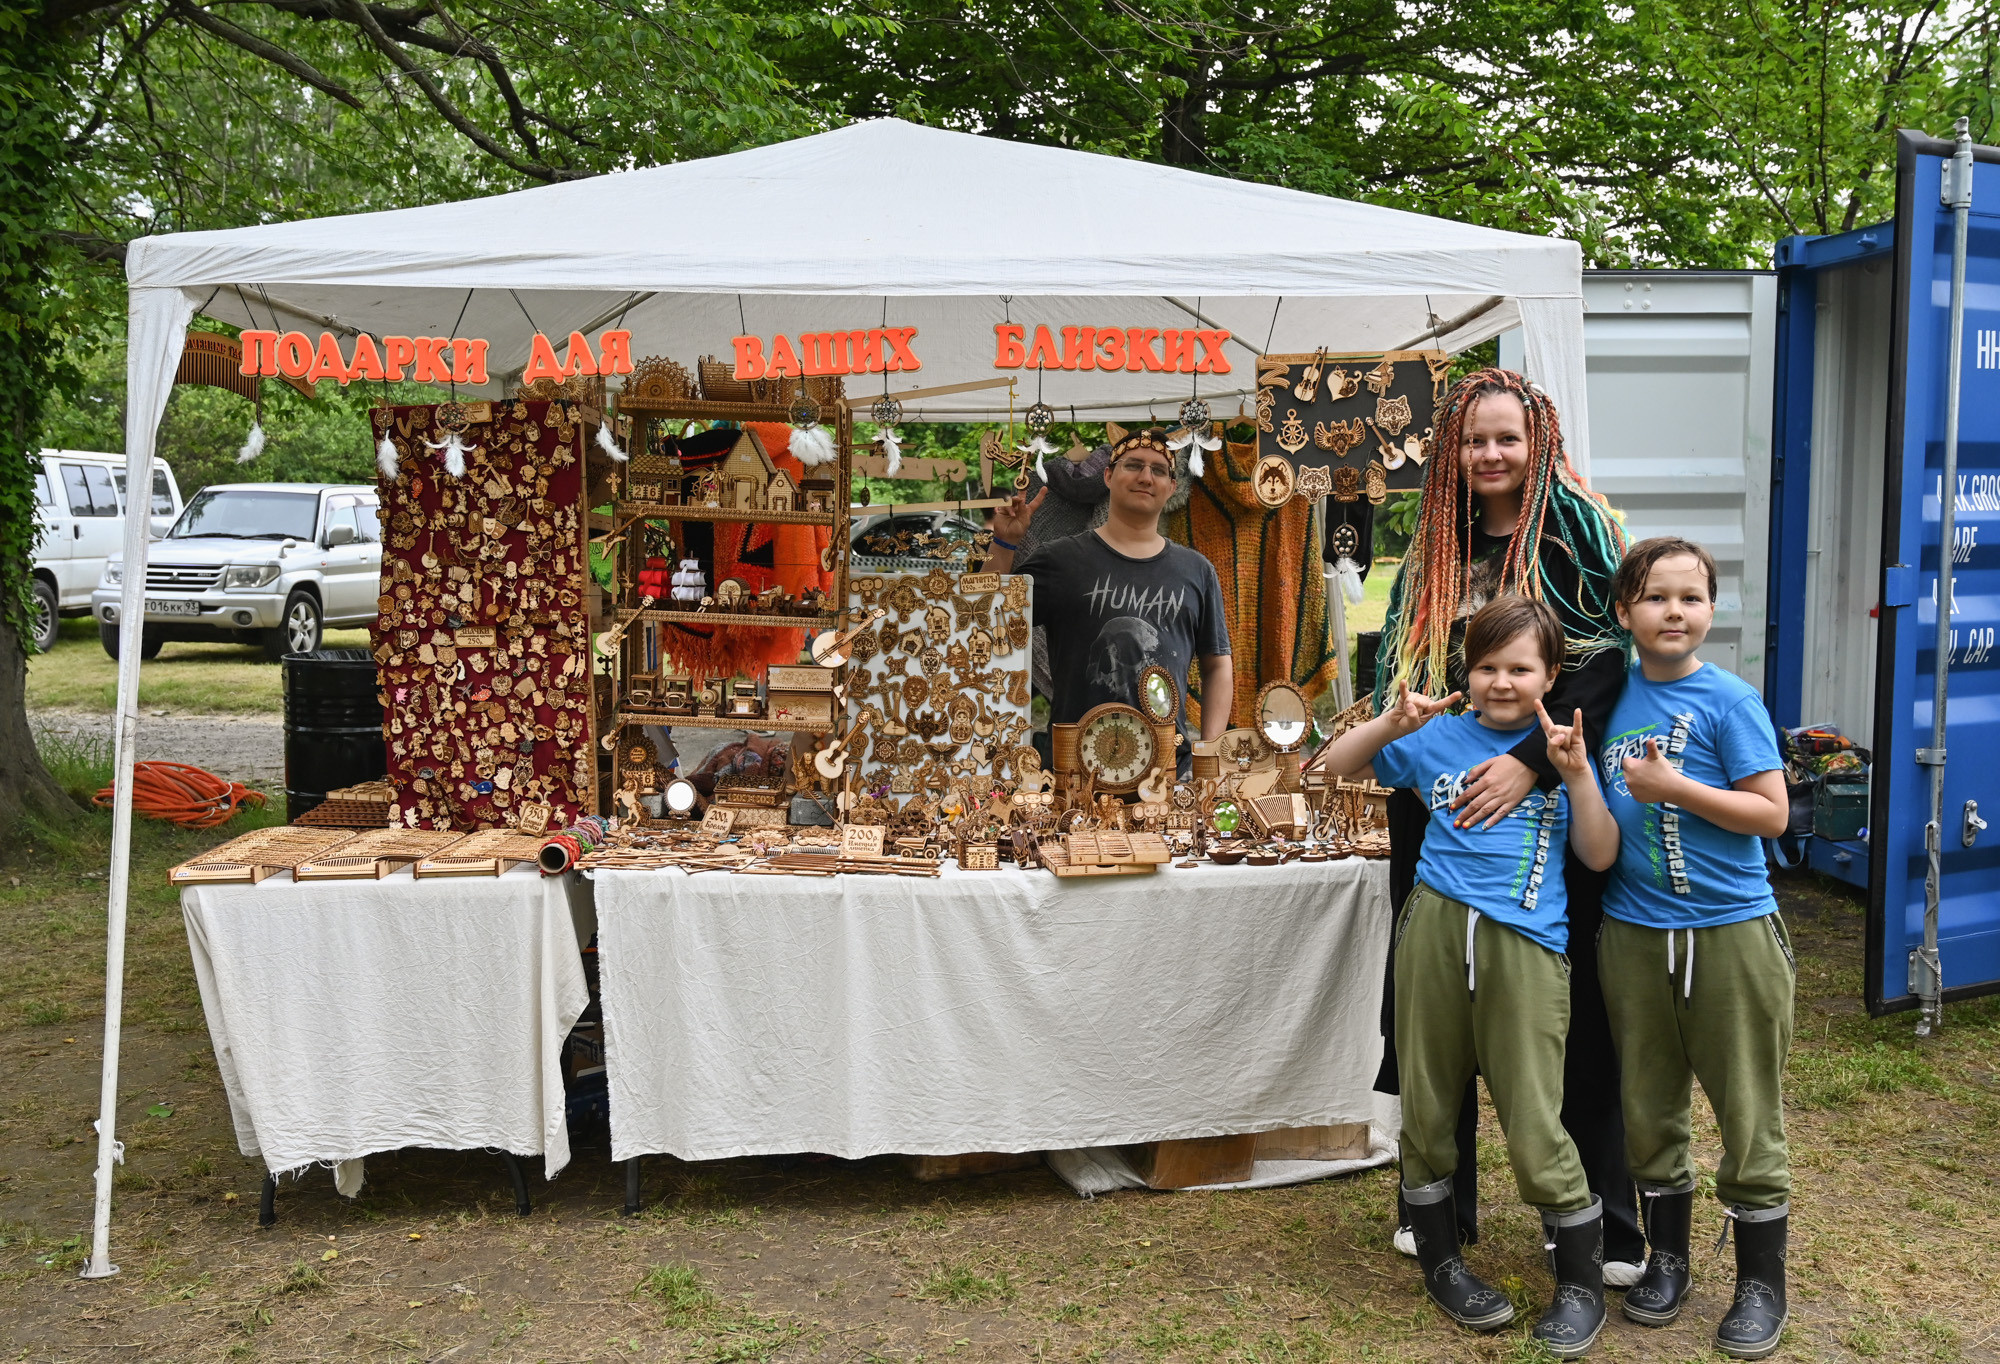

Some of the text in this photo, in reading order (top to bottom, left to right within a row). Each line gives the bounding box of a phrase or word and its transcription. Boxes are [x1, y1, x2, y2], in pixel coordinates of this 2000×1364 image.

[239, 329, 635, 386] ПОДАРКИ ДЛЯ
[731, 323, 1232, 381] ВАШИХ БЛИЗКИХ
[1952, 527, 1978, 562] ARE
[962, 575, 998, 585] МАГНИТЫ
[185, 602, 196, 610] 93
[1083, 574, 1186, 624] HUMAN
[461, 627, 490, 635] ЗНАЧКИ
[1963, 627, 1994, 664] CAP.
[705, 820, 727, 831] Брелок
[849, 828, 879, 842] 200р.
[1521, 829, 1551, 911] scratches
[1546, 784, 1561, 809] th
[1663, 813, 1691, 894] scratches
